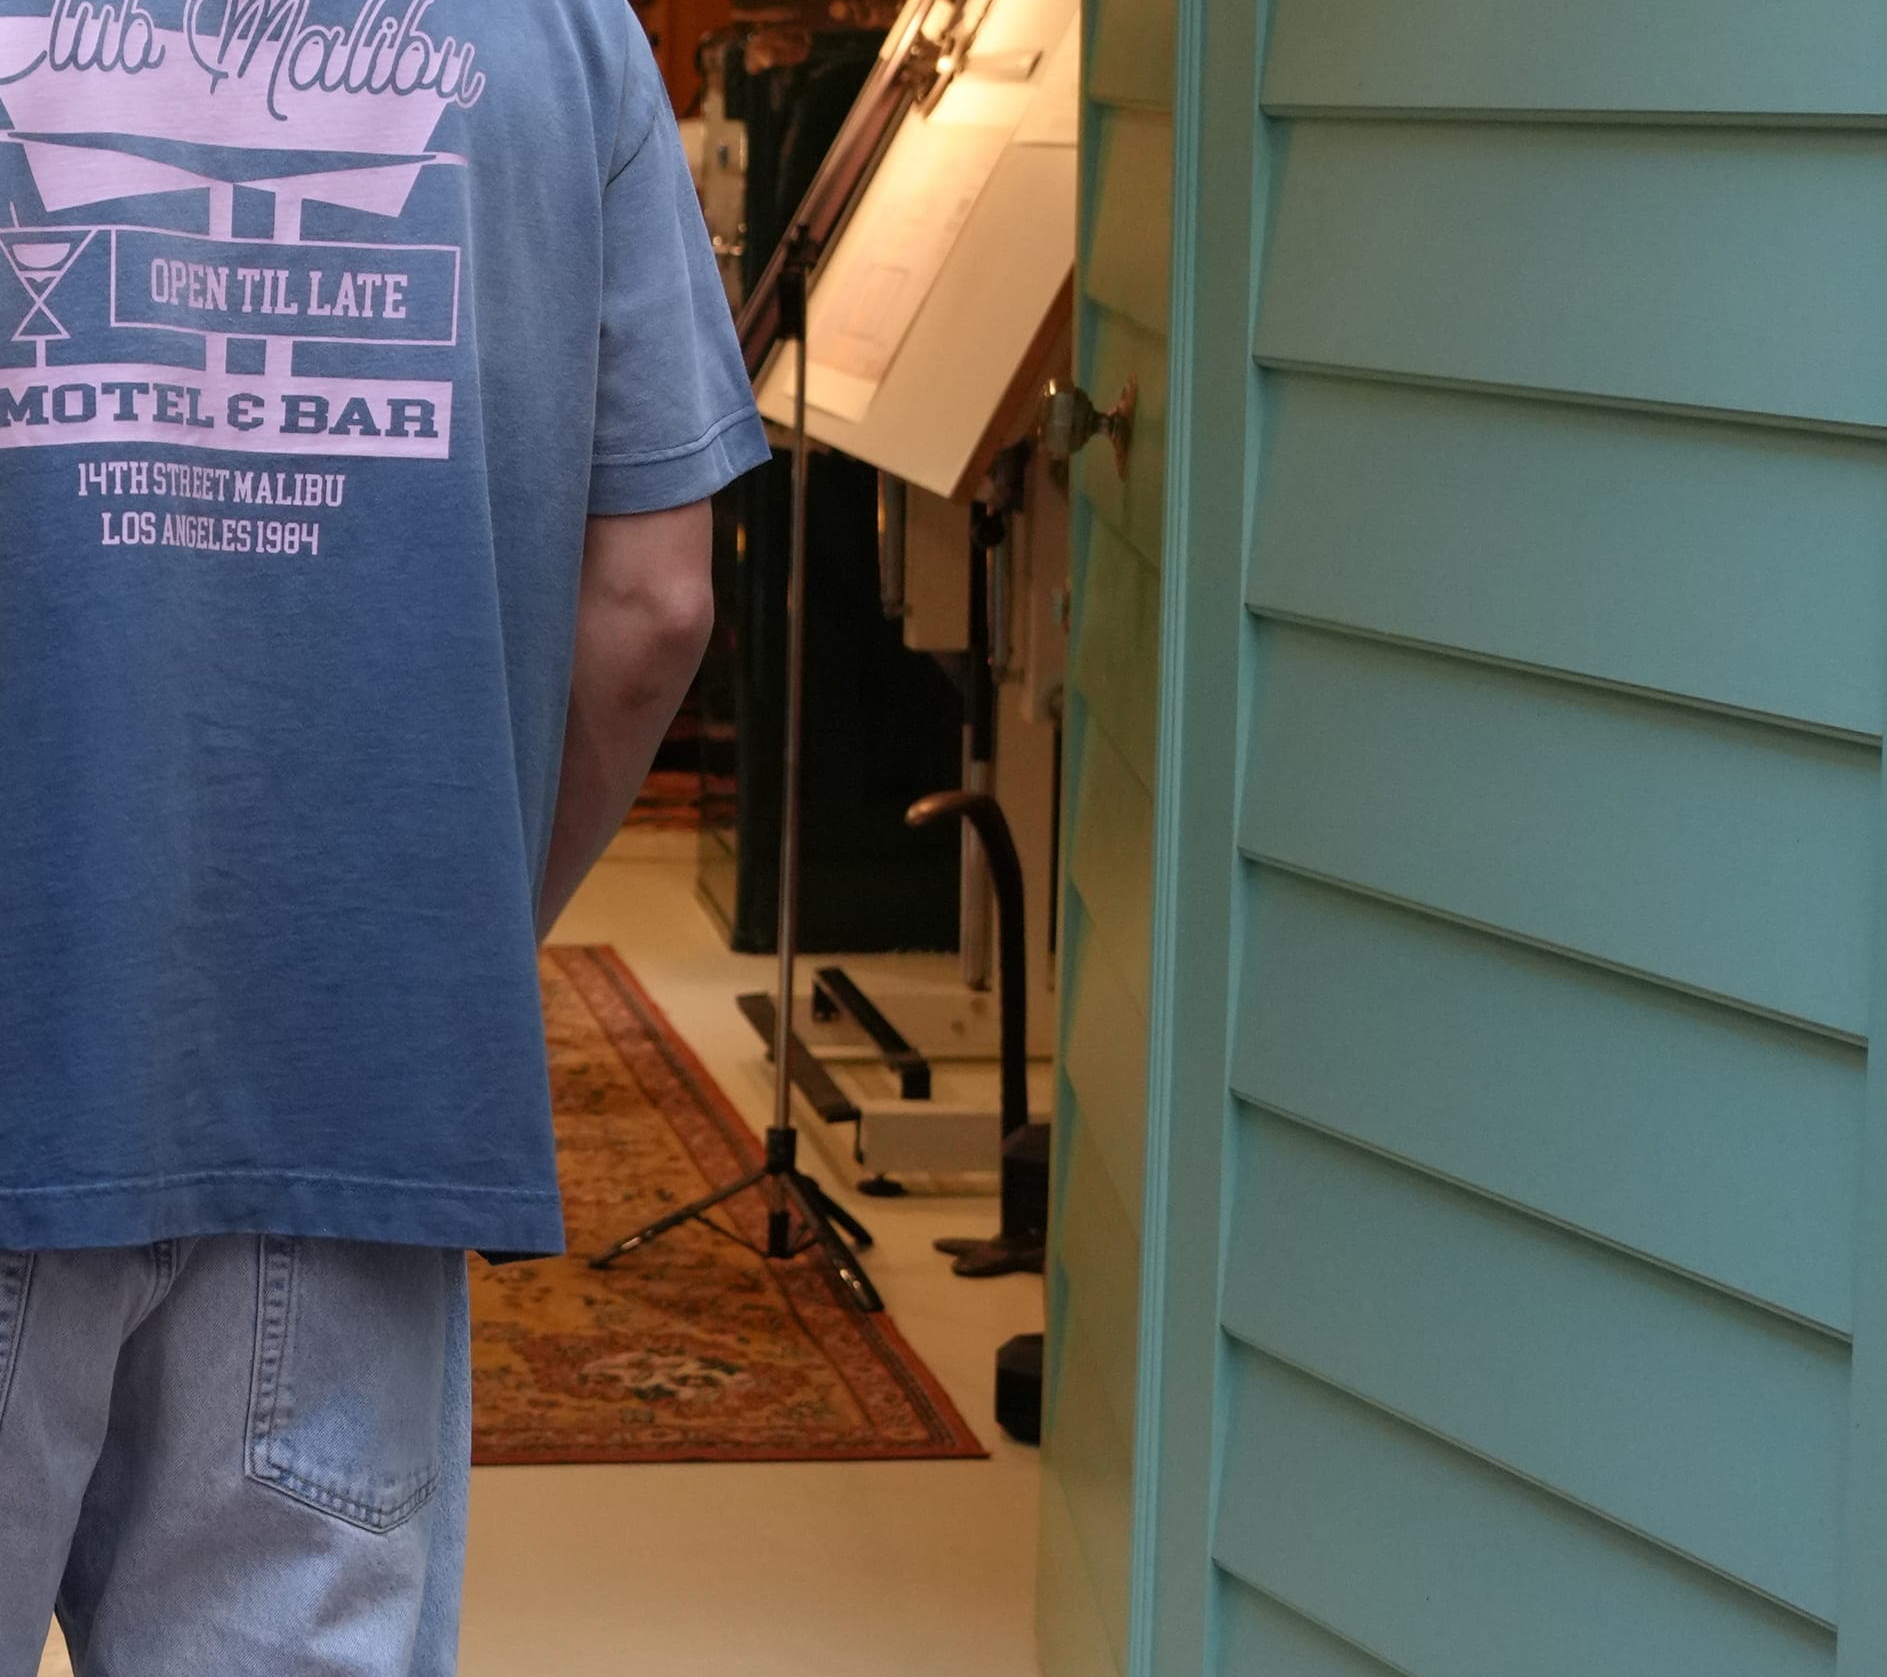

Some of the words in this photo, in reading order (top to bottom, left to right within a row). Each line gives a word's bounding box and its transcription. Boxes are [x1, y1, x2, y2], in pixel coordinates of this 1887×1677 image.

[150, 258, 227, 311] OPEN
[237, 266, 299, 316] TIL
[307, 270, 409, 319] LATE
[226, 392, 265, 432] &
[279, 393, 439, 439] BAR
[78, 461, 148, 496] 14TH
[153, 464, 229, 502] STREET
[233, 469, 346, 507] MALIBU
[102, 512, 156, 545] LOS
[161, 514, 251, 552] ANGELES
[256, 519, 319, 556] 1984
